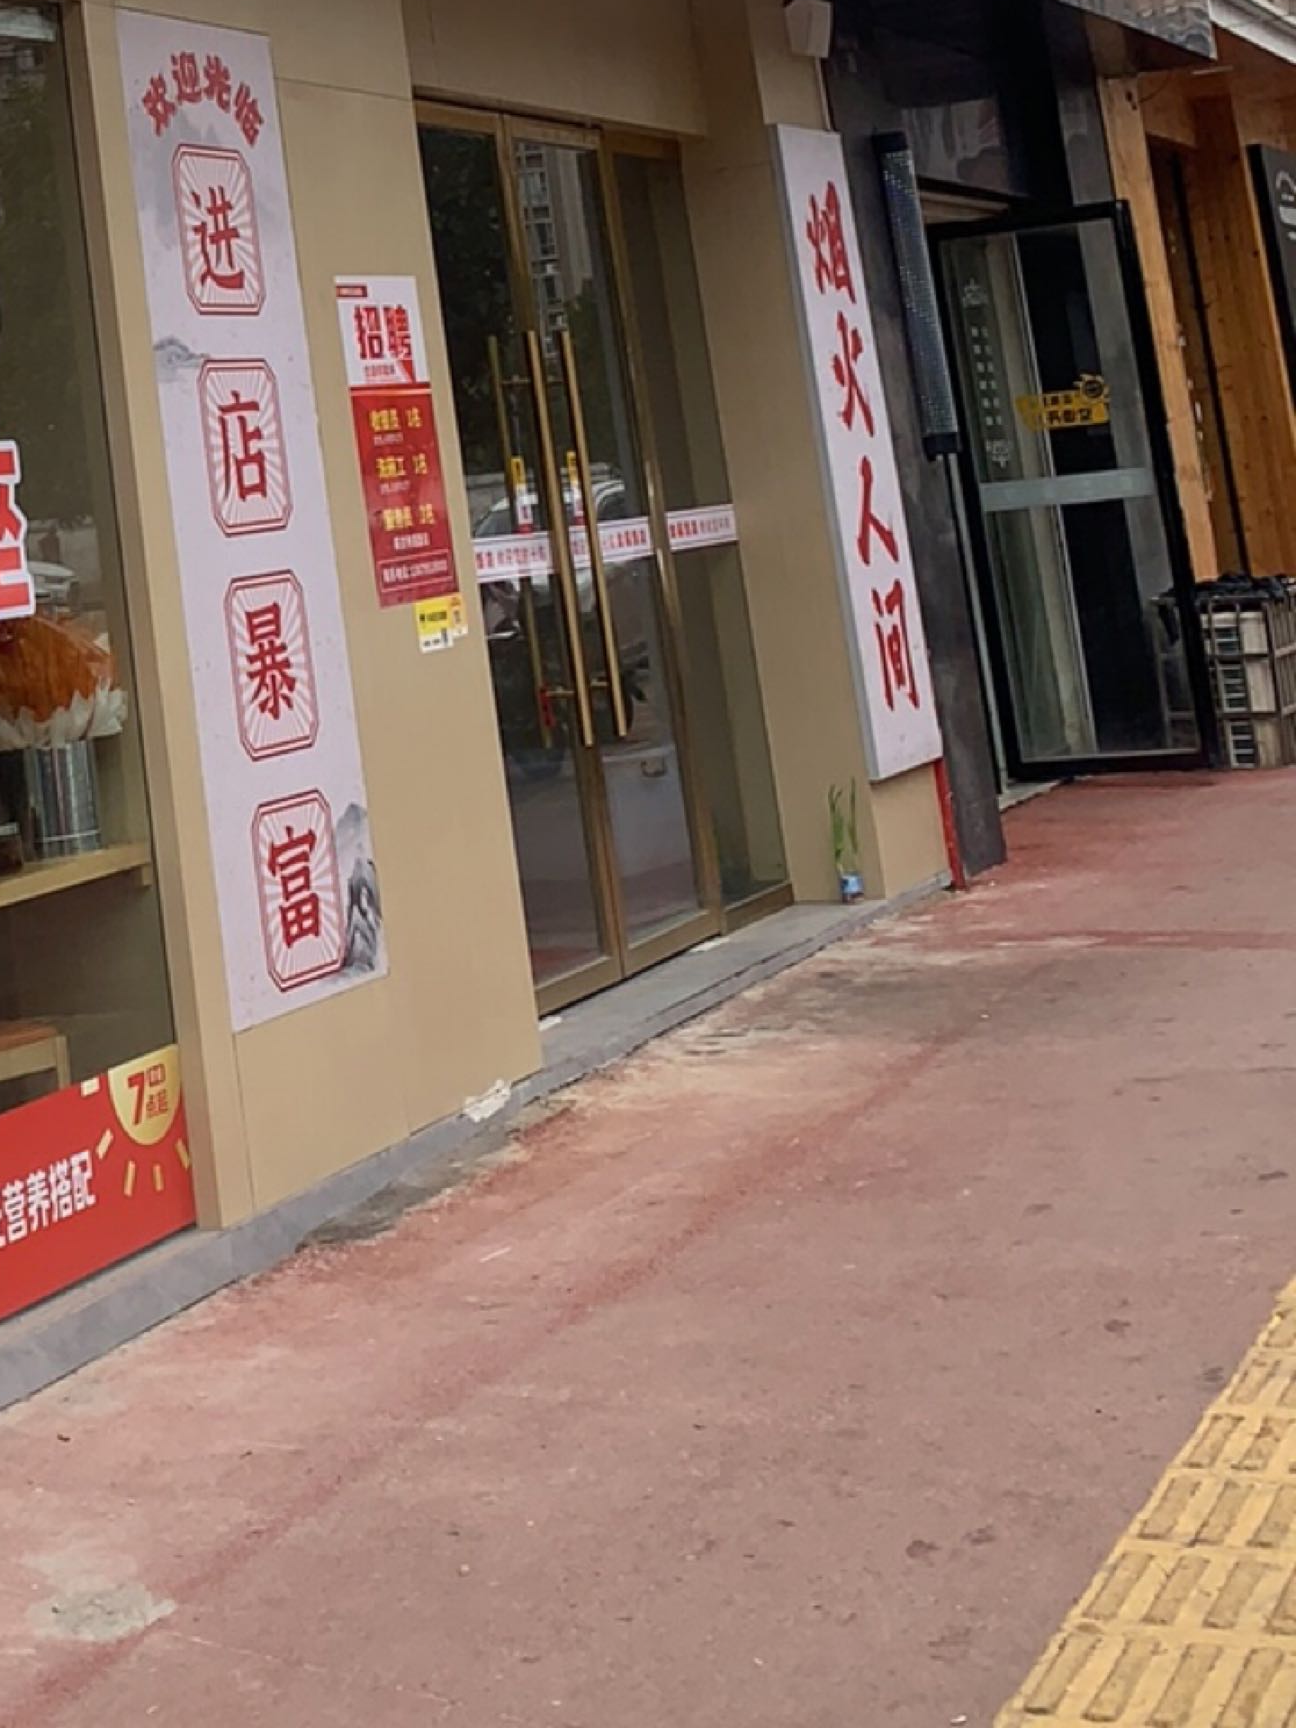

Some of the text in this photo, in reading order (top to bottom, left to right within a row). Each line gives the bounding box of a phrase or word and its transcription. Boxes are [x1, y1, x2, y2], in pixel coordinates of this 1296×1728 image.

[142, 51, 264, 148] 欢迎光临
[355, 306, 412, 359] 招聘
[806, 181, 920, 712] 烟火人间
[194, 184, 321, 949] 进店暴富
